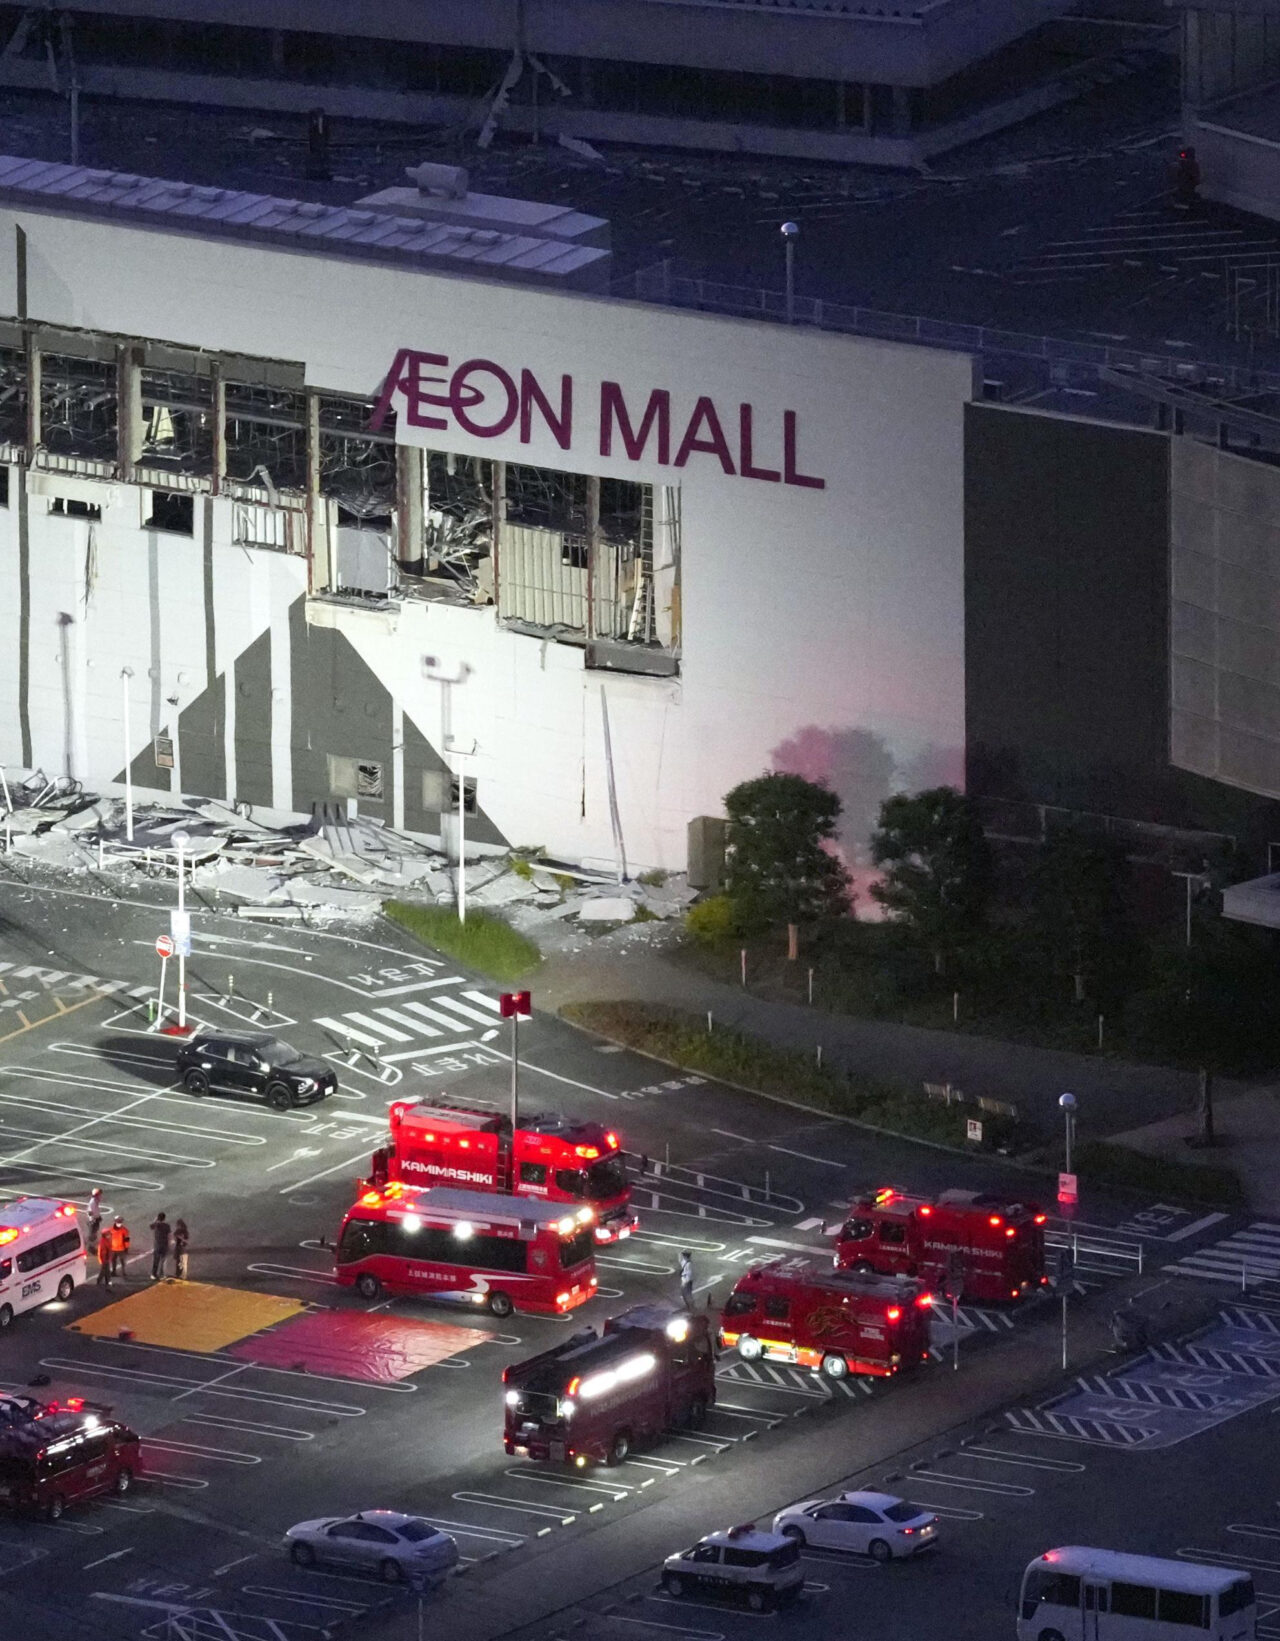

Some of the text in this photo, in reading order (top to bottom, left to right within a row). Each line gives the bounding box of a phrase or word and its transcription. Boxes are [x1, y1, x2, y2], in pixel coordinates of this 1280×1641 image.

[599, 380, 826, 490] MALL
[411, 1051, 502, 1077] 止まれ
[401, 1159, 493, 1185] KAMIMASHIKI
[21, 1280, 42, 1298] EMS
